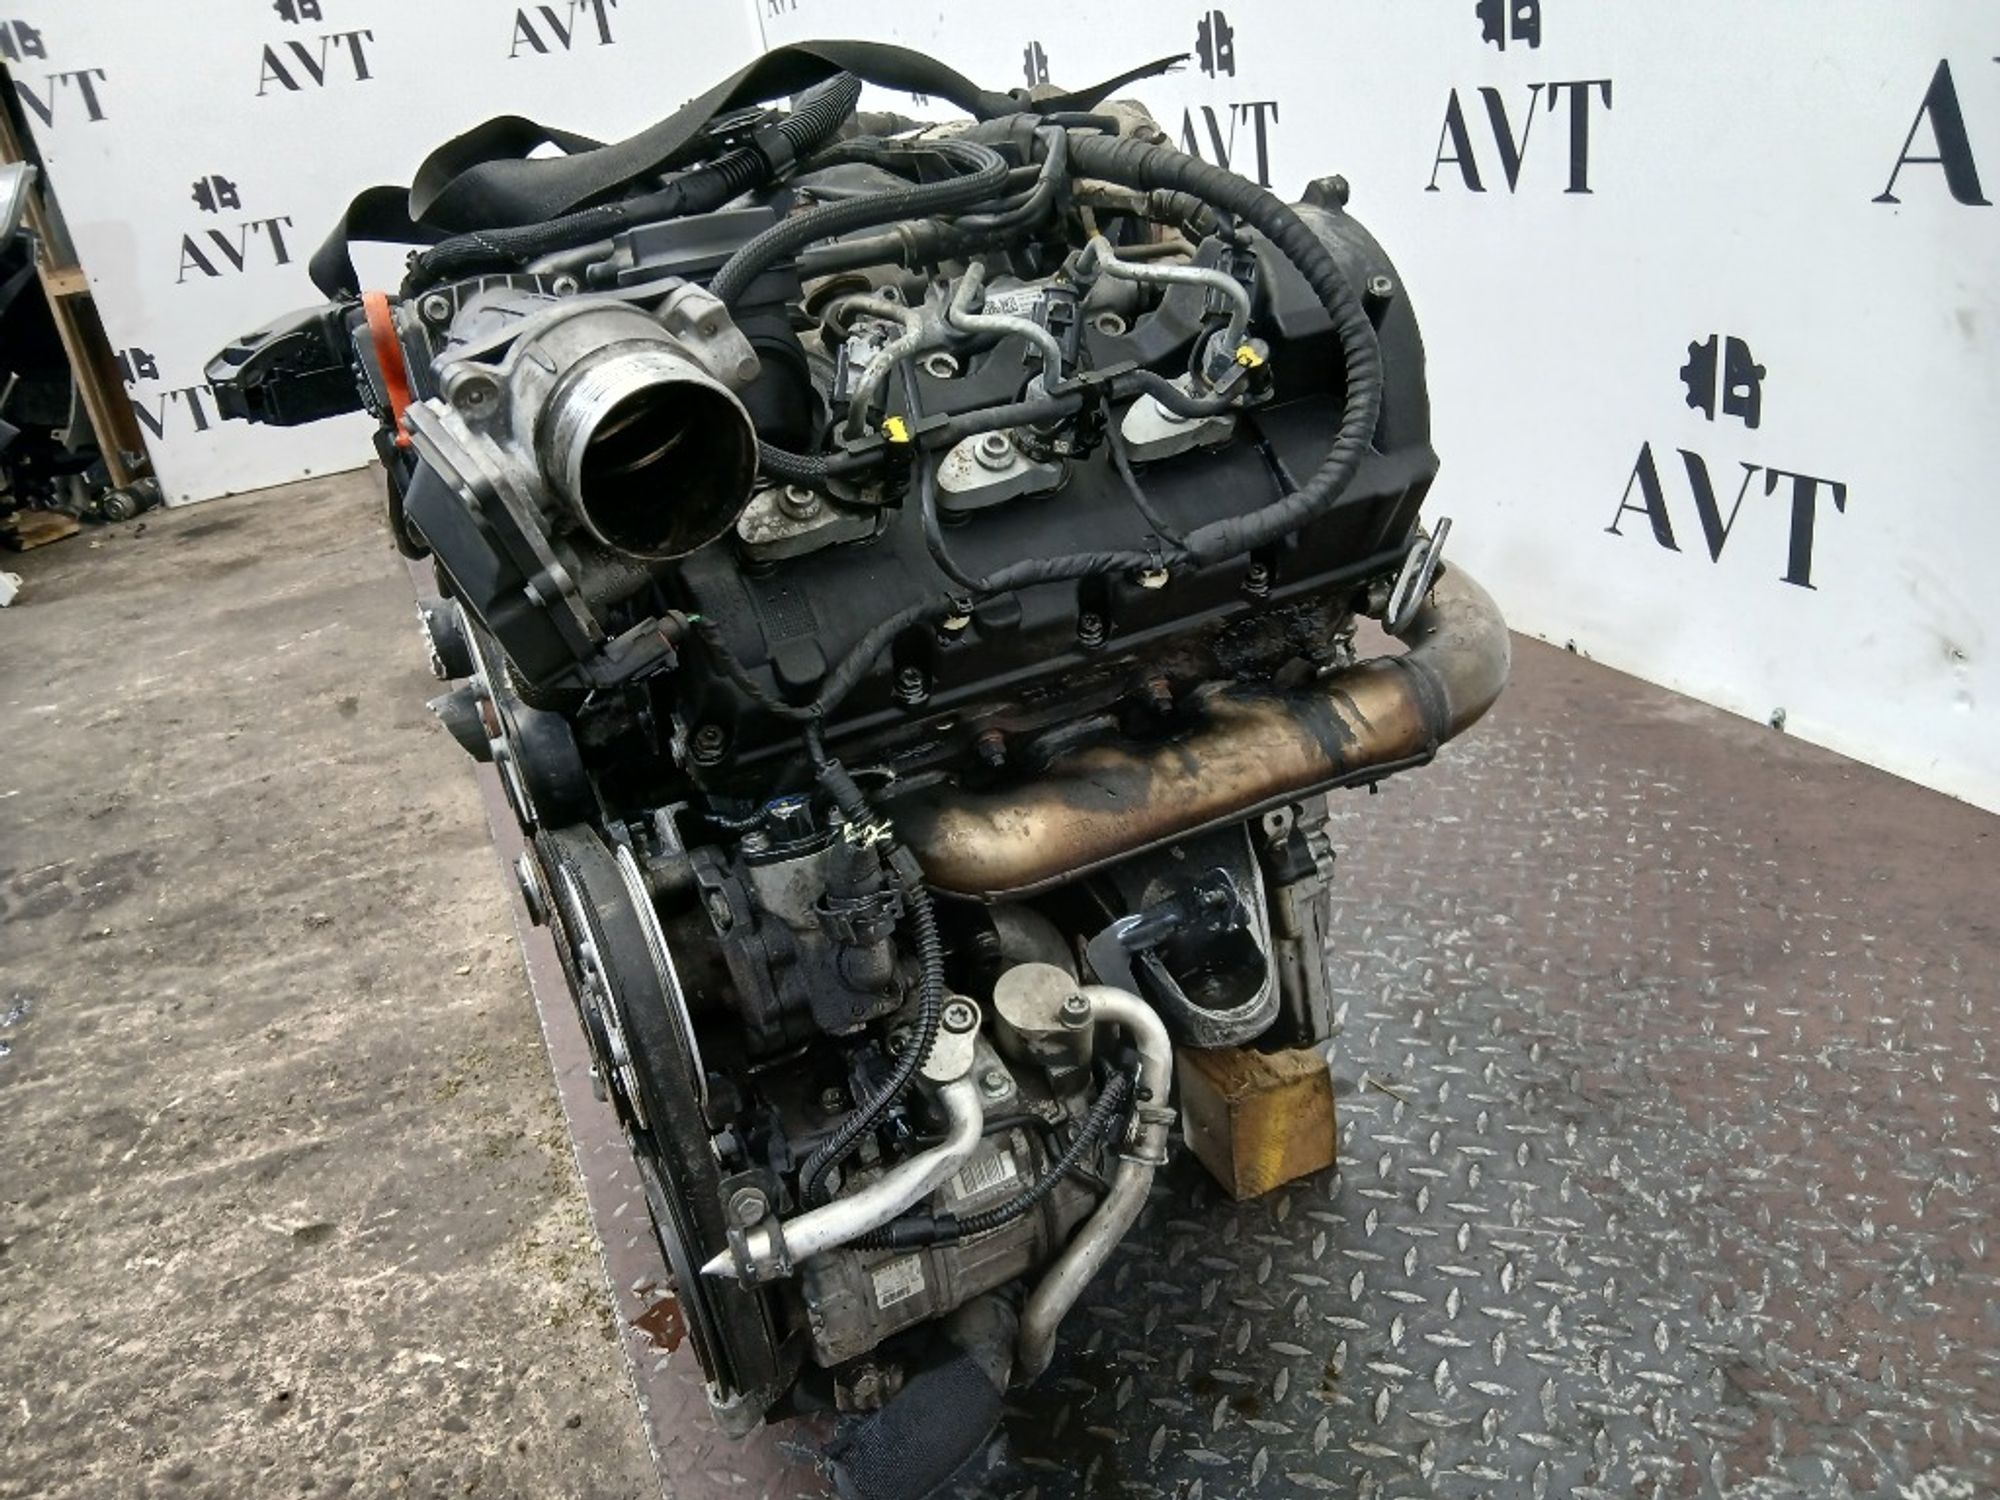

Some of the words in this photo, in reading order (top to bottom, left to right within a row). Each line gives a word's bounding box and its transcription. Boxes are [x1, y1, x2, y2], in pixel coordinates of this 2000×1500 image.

[255, 29, 374, 97] AVT
[508, 0, 617, 58] AVT
[12, 68, 109, 129] VT
[1871, 57, 2000, 207] A
[1424, 79, 1612, 194] AVT
[175, 216, 293, 284] AVT
[131, 385, 212, 441] VT
[1604, 440, 1847, 591] AVT
